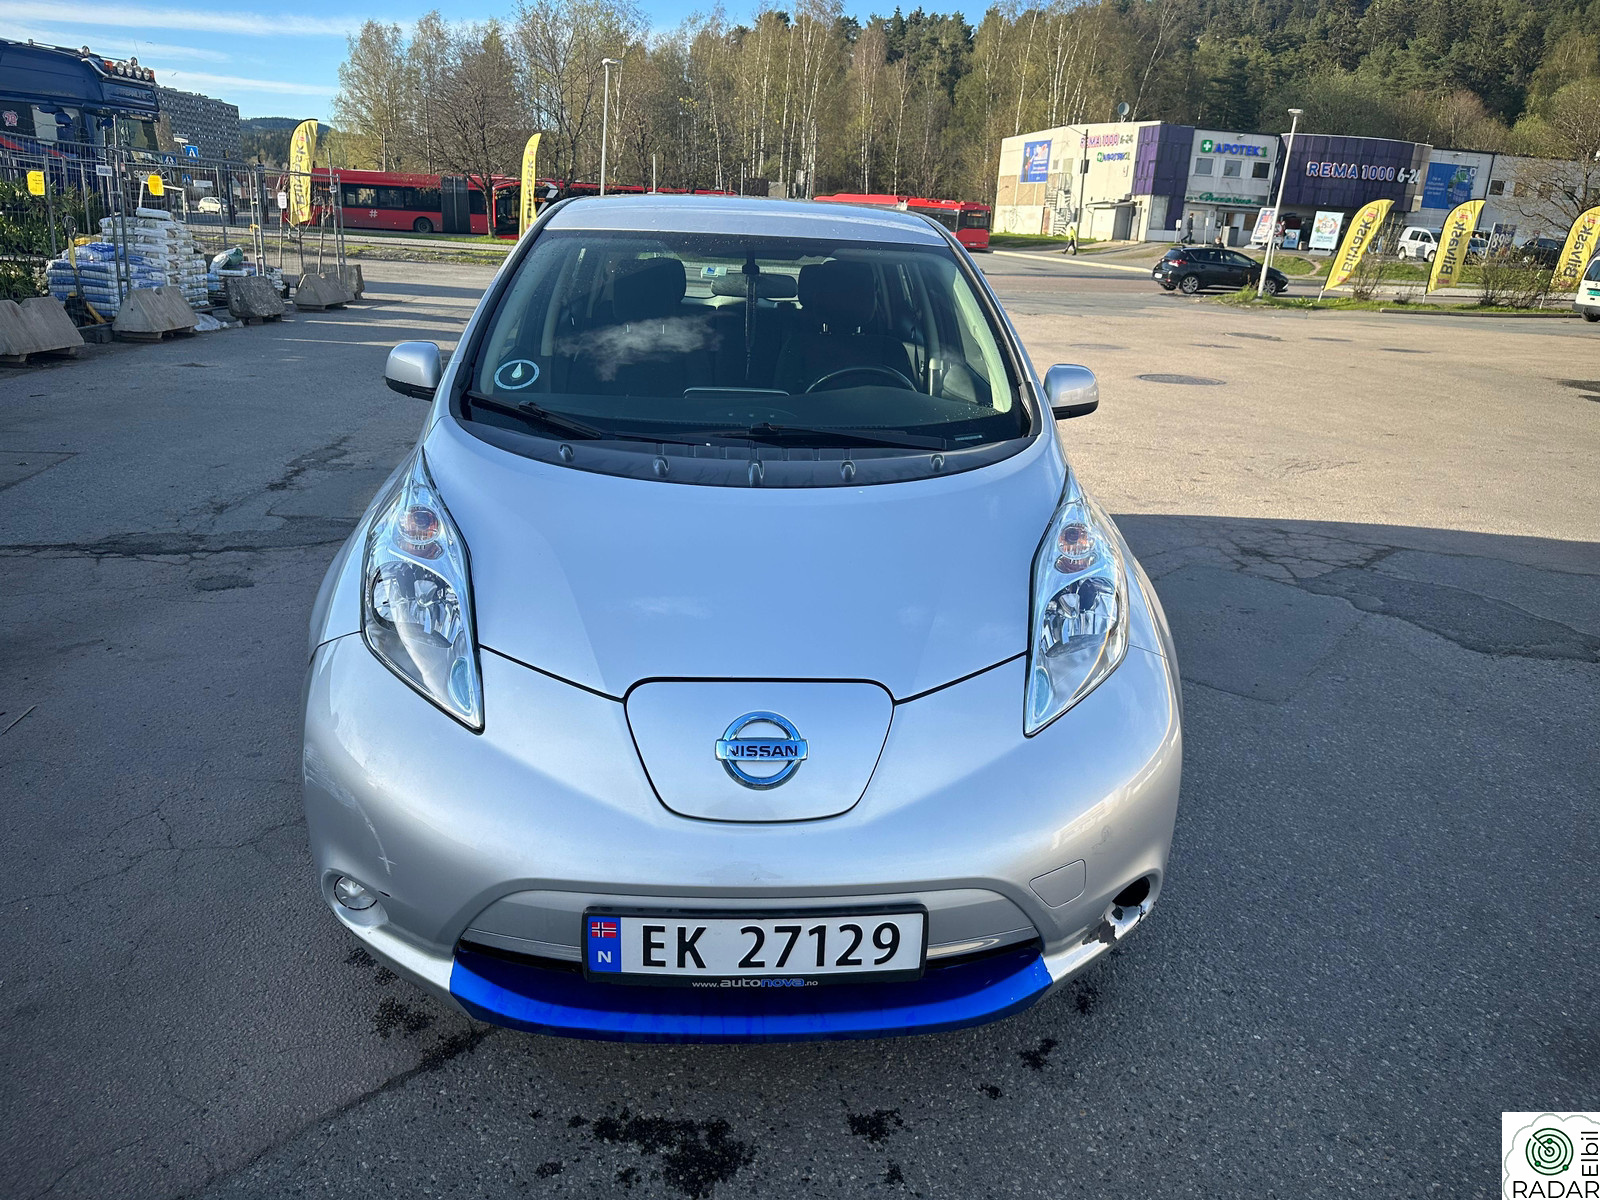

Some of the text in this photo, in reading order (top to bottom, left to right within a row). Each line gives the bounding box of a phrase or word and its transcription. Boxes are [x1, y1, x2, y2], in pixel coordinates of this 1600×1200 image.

[1306, 160, 1358, 180] REMA
[1361, 164, 1396, 182] 1000
[726, 744, 799, 757] NISSAN
[642, 921, 901, 969] EK 27129
[597, 950, 612, 963] N
[692, 977, 819, 988] www.autonova.no
